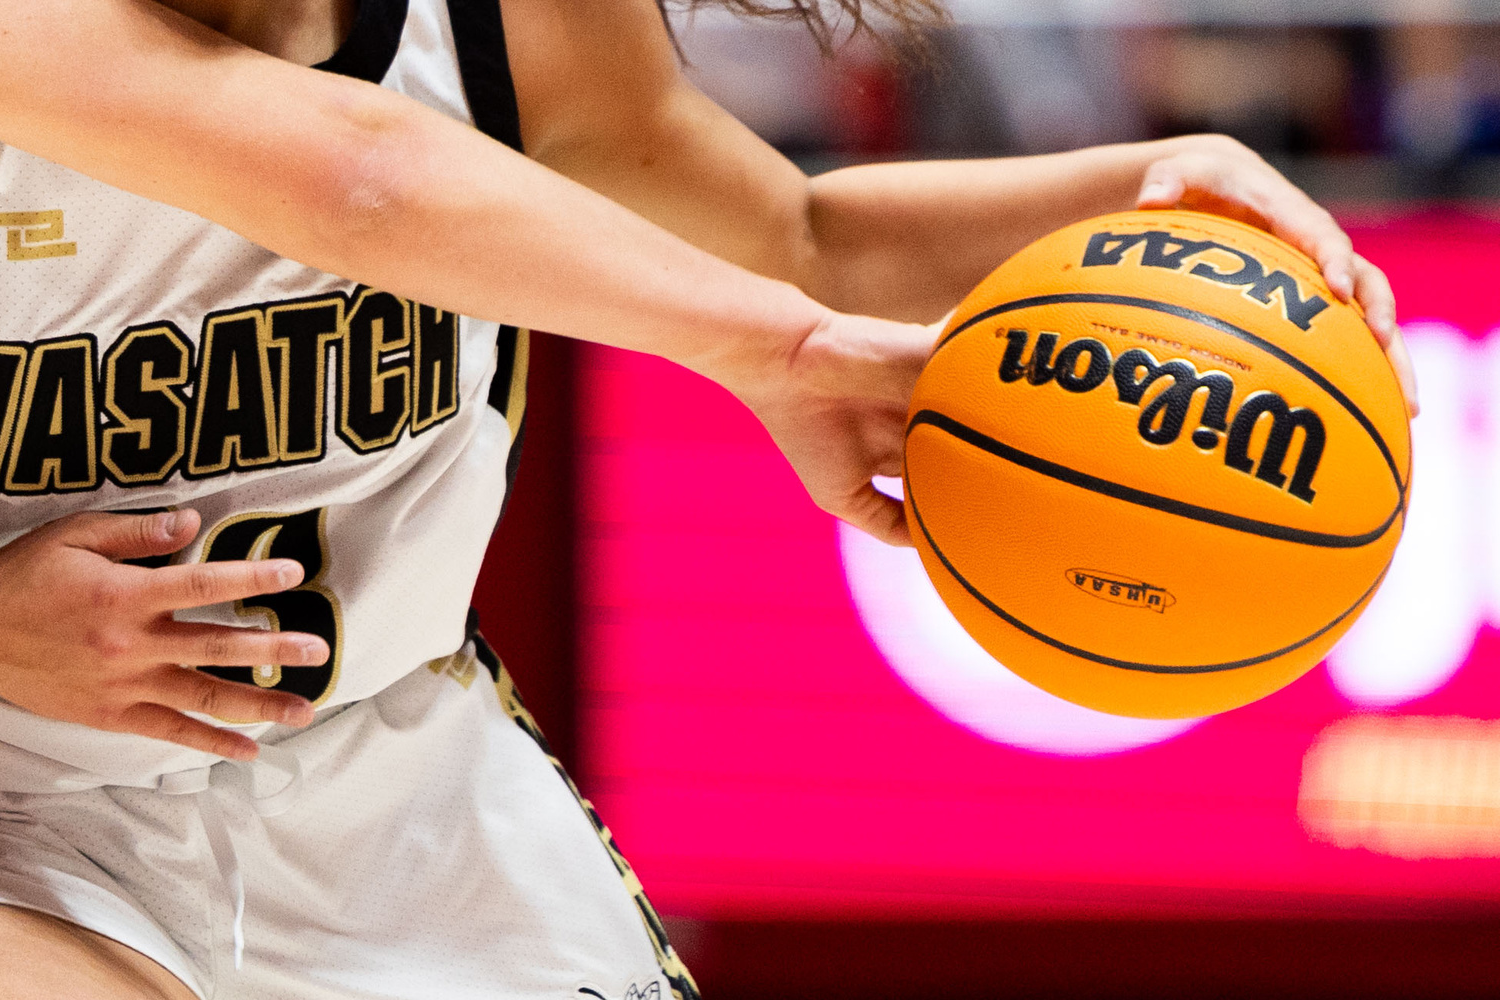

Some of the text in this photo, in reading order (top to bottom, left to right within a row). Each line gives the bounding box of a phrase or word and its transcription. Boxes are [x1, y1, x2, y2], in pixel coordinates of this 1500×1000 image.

[1082, 229, 1330, 331] NCAA
[1091, 322, 1252, 372] INDOOR GAME BALL
[999, 328, 1326, 504] Wilson
[1075, 573, 1162, 606] UHSAA
